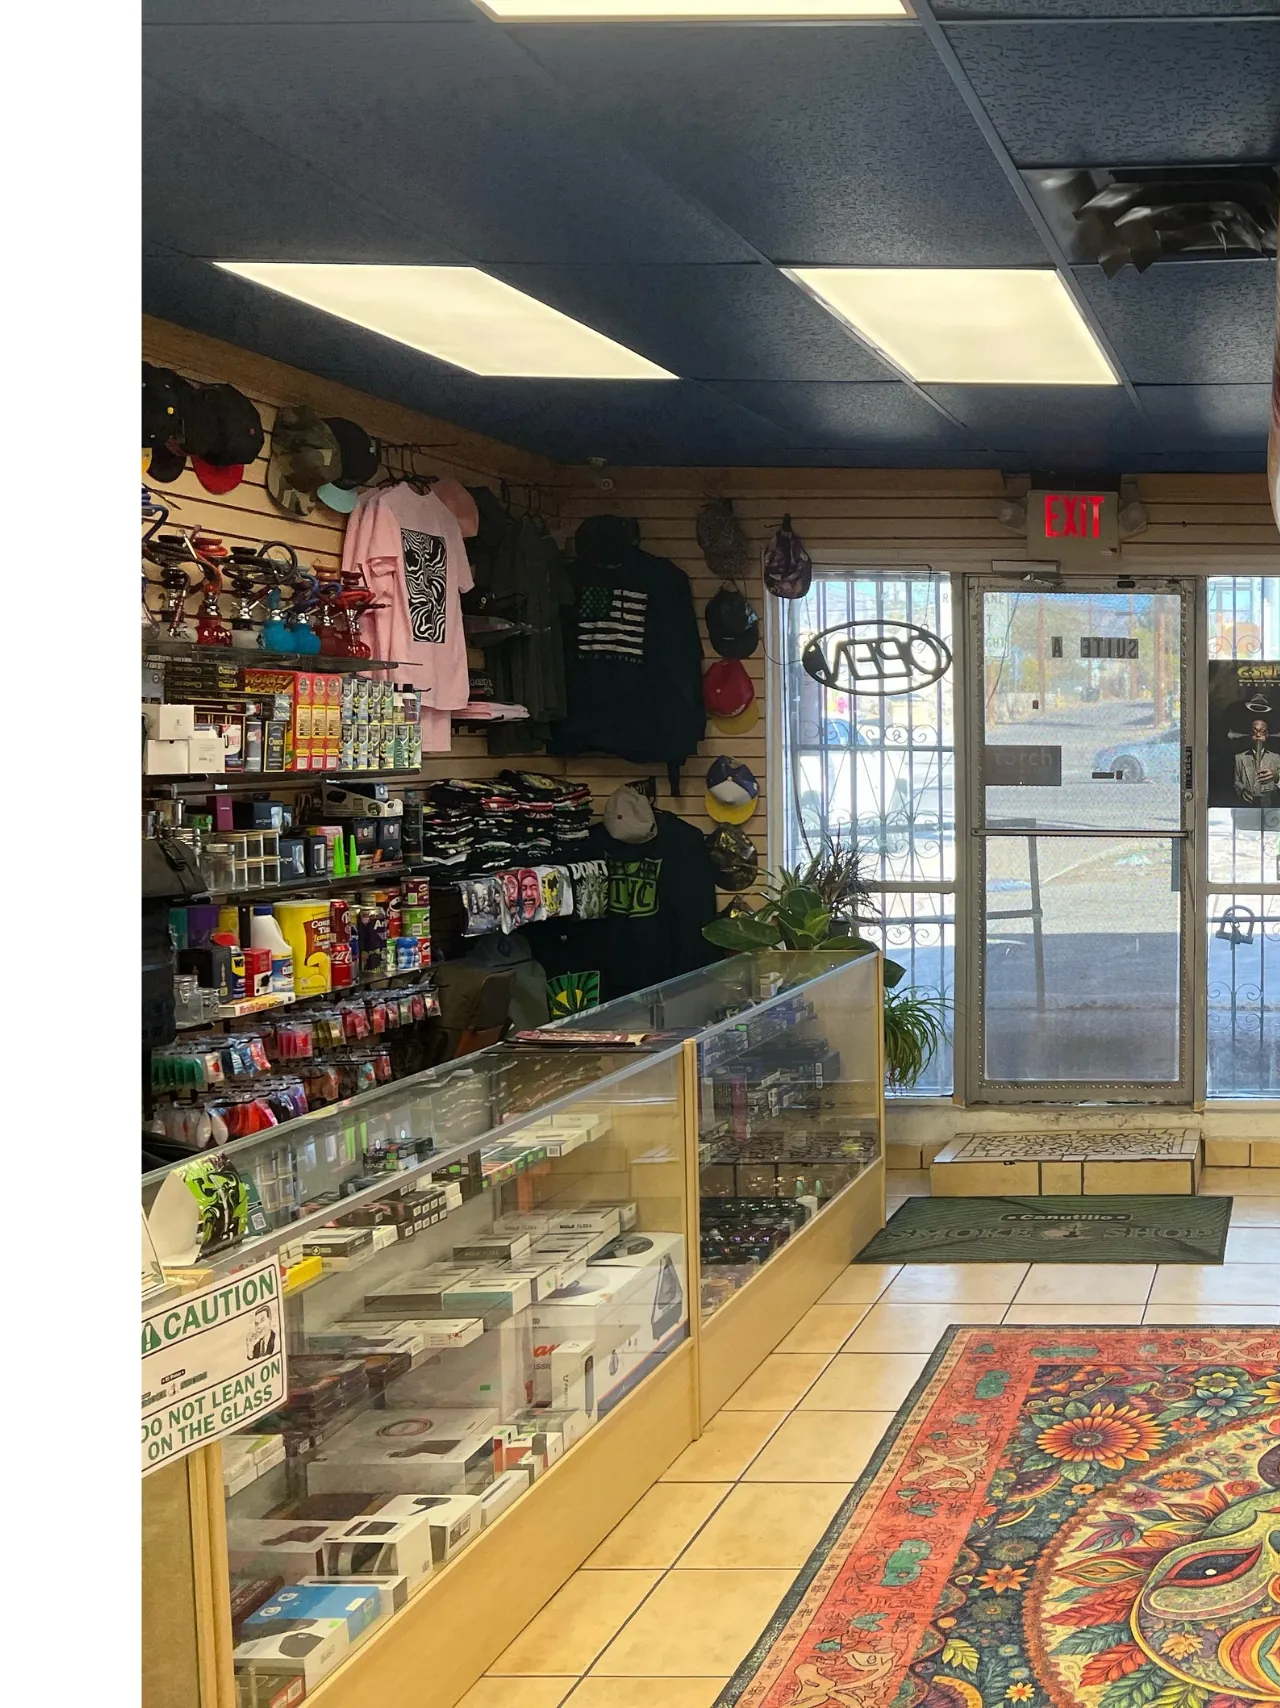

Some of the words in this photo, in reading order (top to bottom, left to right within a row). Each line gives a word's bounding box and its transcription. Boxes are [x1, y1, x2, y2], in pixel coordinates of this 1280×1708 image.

[1045, 495, 1105, 539] EXIT
[885, 1227, 1036, 1240] SMOKE
[1102, 1227, 1215, 1240] SHOP
[1020, 1213, 1113, 1222] Canutillo
[163, 1270, 274, 1341] CAUTION
[168, 1396, 206, 1429] NOT
[211, 1372, 255, 1410] LEAN
[260, 1358, 281, 1384] ON
[148, 1433, 173, 1461] ON
[177, 1413, 216, 1444] THE
[220, 1384, 273, 1425] GLASS
